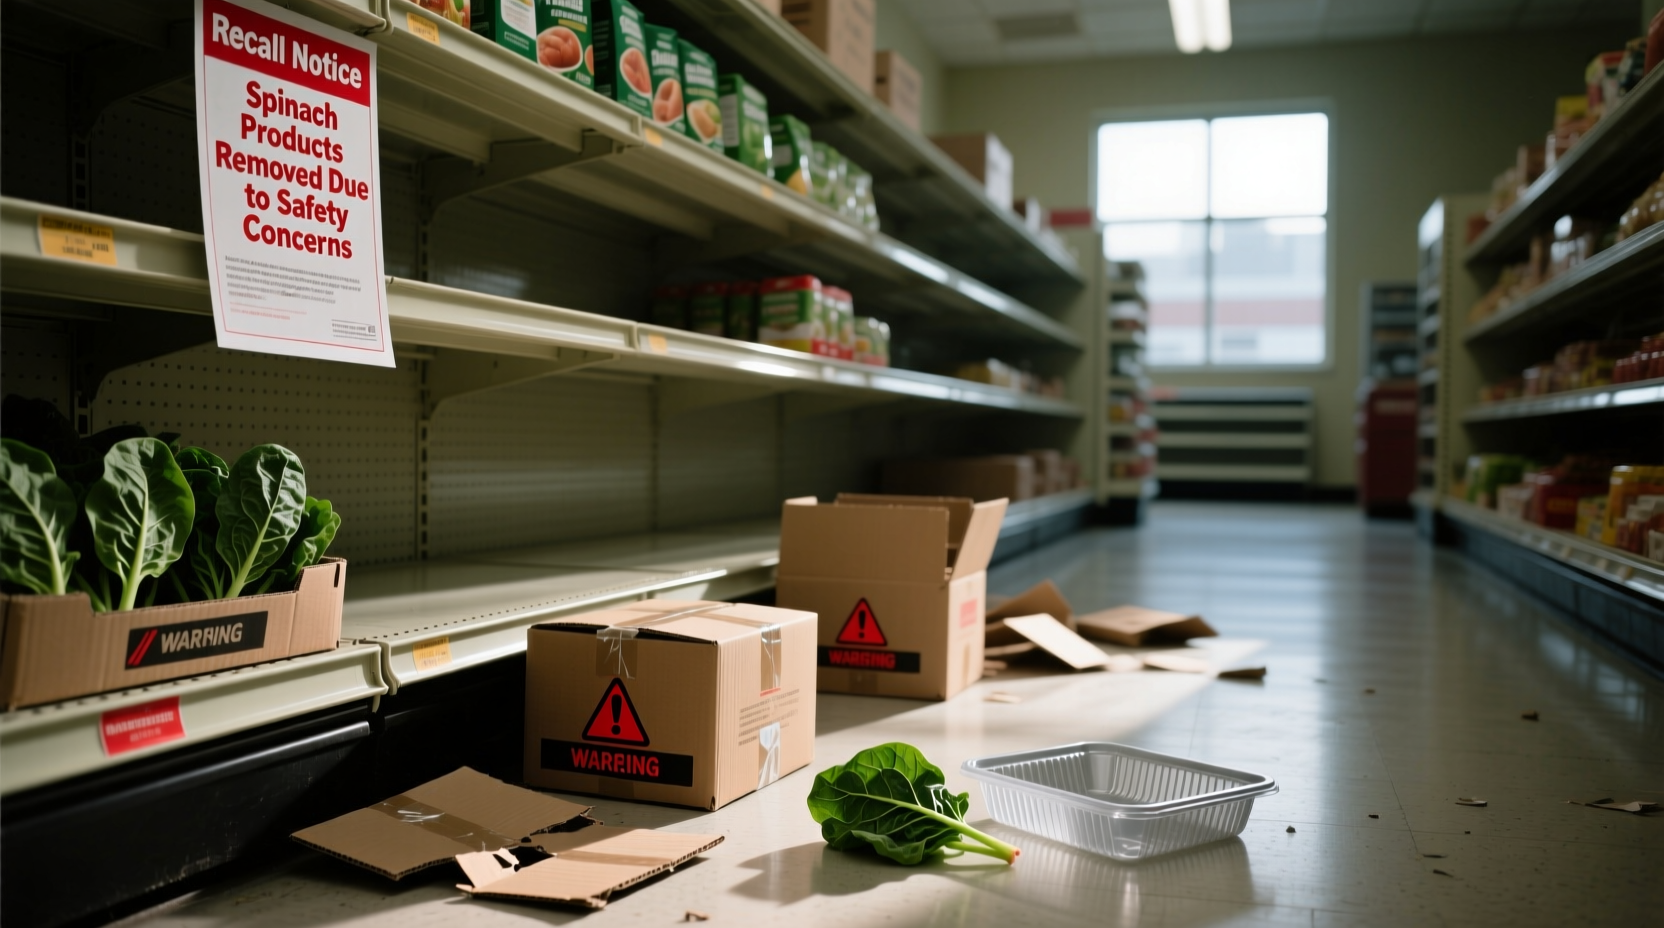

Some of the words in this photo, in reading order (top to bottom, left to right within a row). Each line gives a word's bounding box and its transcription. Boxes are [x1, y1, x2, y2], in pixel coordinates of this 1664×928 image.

[212, 12, 285, 65] Recall
[292, 40, 362, 89] Notice
[246, 80, 338, 131] Spinach
[241, 112, 344, 163] Products
[215, 140, 323, 191] Removed
[328, 167, 369, 201] Due
[244, 183, 271, 211] to
[276, 188, 349, 233] Safety
[243, 213, 353, 259] Concerns
